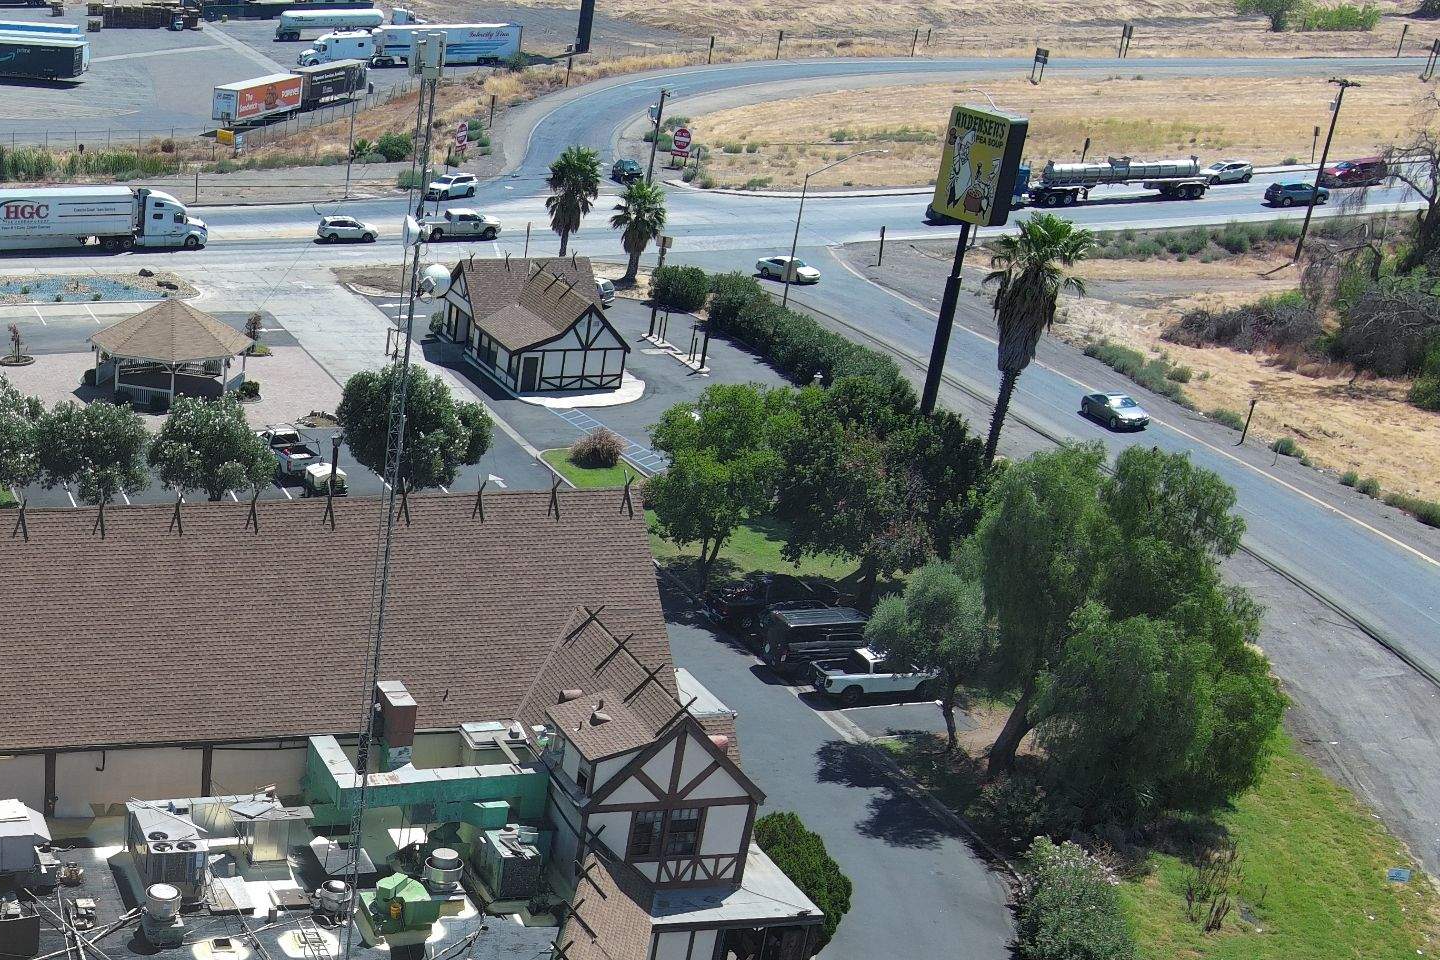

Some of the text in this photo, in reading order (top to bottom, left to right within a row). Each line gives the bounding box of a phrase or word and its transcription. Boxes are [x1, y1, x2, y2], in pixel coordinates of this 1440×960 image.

[245, 93, 253, 101] The
[976, 135, 1004, 149] PEA SOUP
[3, 203, 49, 220] HGC
